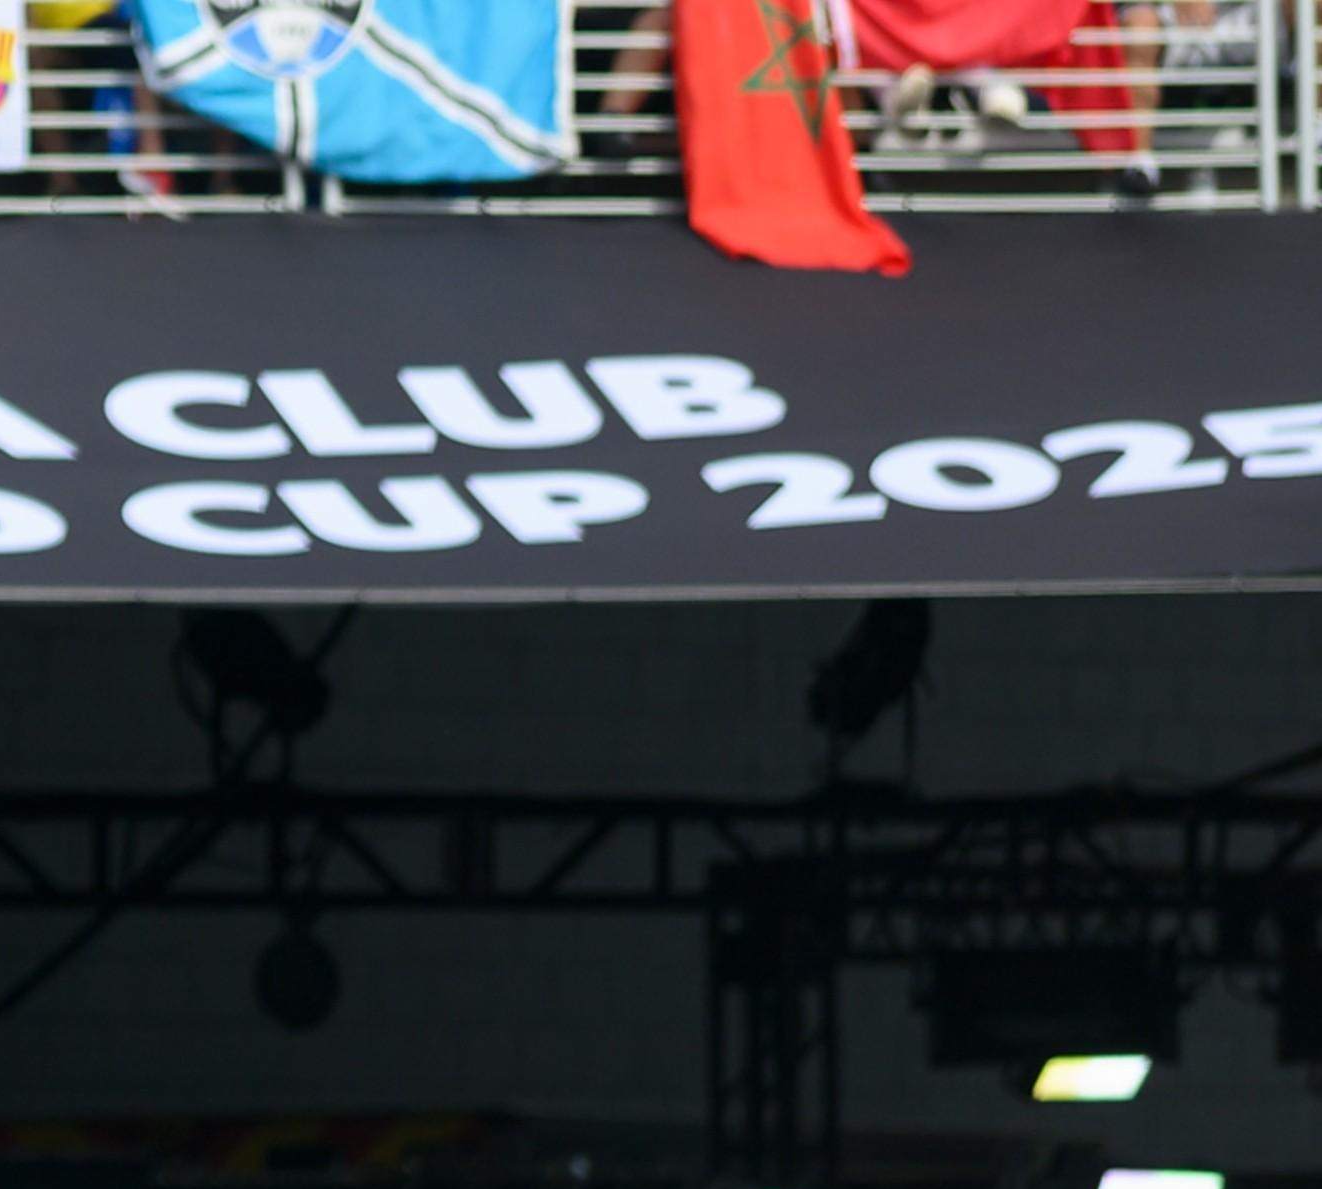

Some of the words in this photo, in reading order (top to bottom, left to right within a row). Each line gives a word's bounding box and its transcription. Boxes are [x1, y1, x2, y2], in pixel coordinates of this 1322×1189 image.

[103, 355, 787, 459] CLUB
[121, 472, 649, 556] CUP
[701, 403, 1322, 531] 2025
